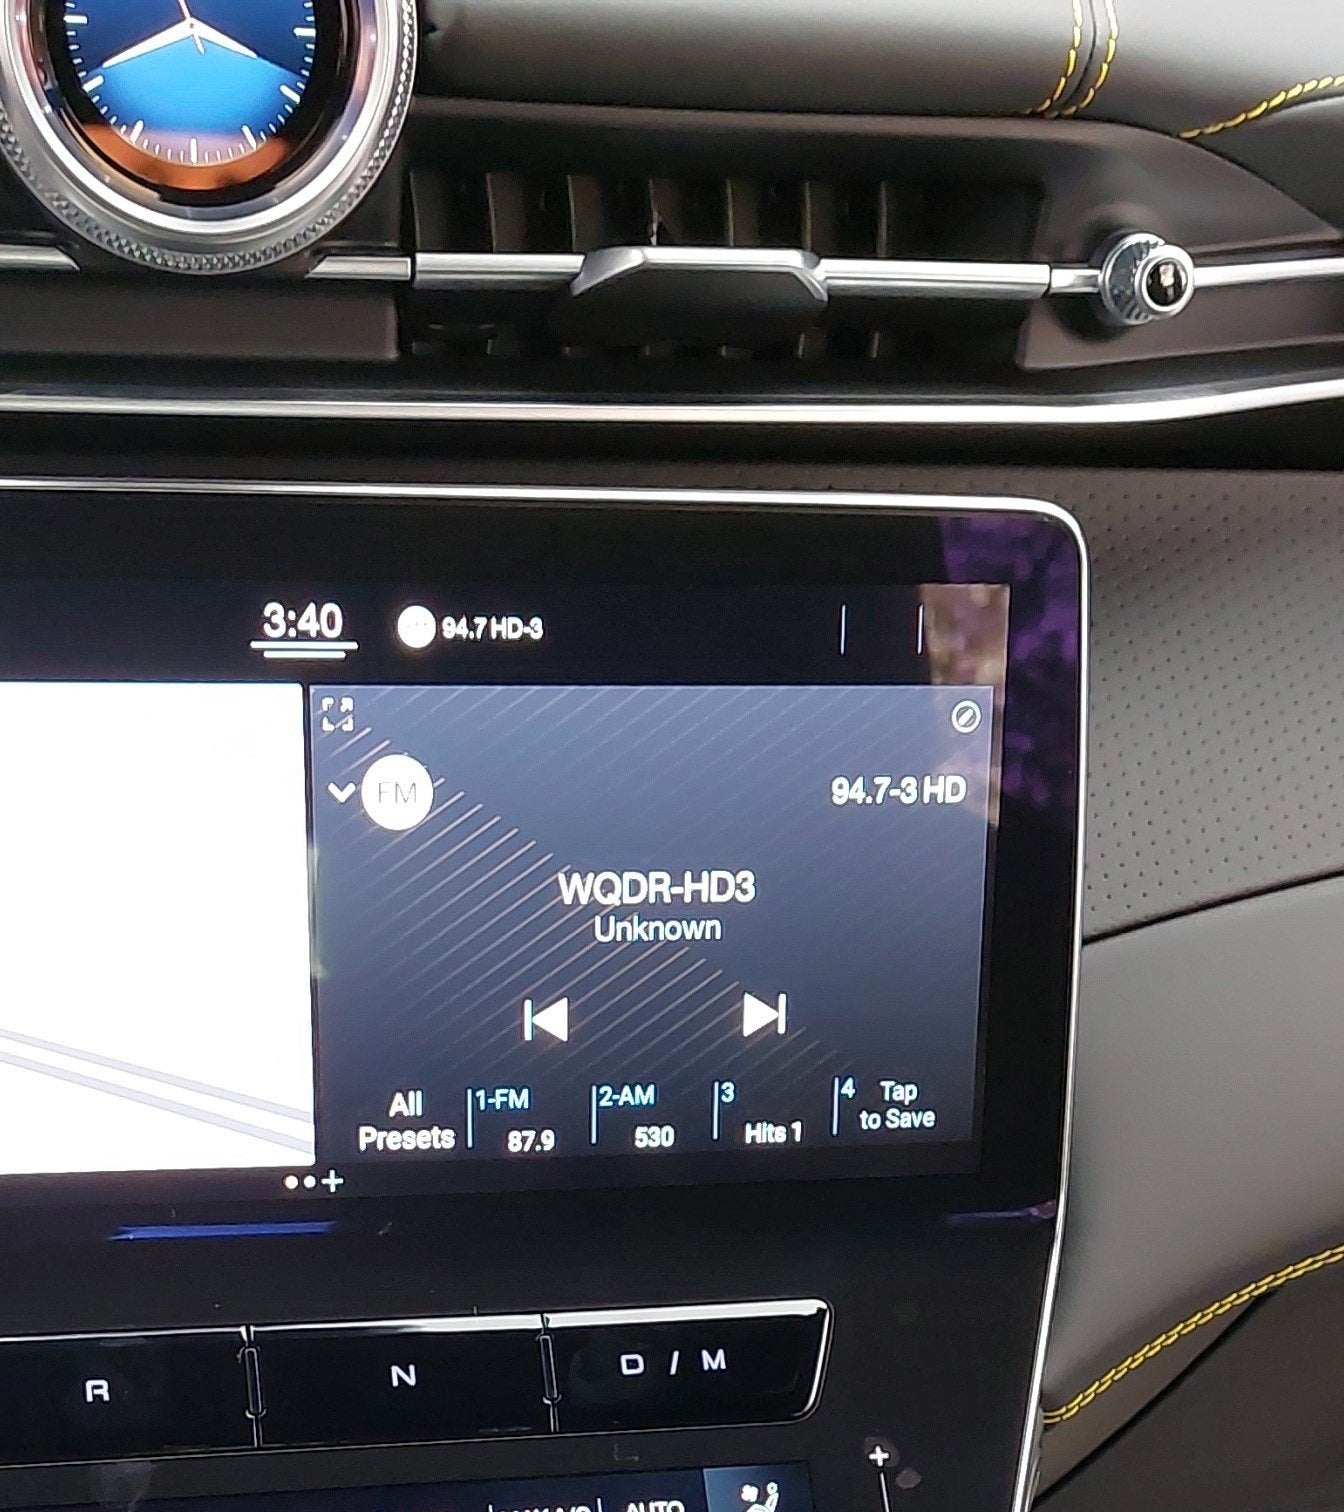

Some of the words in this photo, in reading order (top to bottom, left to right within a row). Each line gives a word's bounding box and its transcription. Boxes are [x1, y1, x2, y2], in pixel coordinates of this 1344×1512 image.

[262, 602, 344, 640] 3:40
[442, 616, 488, 640] 94.7
[490, 616, 544, 640] HD-3
[377, 779, 418, 805] FM
[831, 776, 918, 805] 94.7-3
[921, 775, 967, 804] HD
[557, 870, 756, 906] WQDR-HD3
[593, 915, 723, 943] Unknown
[475, 1087, 530, 1112] 1-FM
[598, 1084, 655, 1108] 2-AM
[721, 1082, 736, 1104] 3
[840, 1077, 856, 1099] 4
[880, 1079, 918, 1106] Tap
[388, 1089, 424, 1119] All
[859, 1108, 882, 1131] to
[884, 1106, 936, 1130] Save
[357, 1124, 456, 1152] Presets
[506, 1129, 556, 1154] 87.9
[634, 1124, 675, 1148] 530
[744, 1120, 787, 1145] Hits
[791, 1120, 804, 1143] 1
[621, 1354, 645, 1377] D
[701, 1349, 728, 1372] M
[390, 1364, 417, 1388] N
[85, 1380, 111, 1402] R
